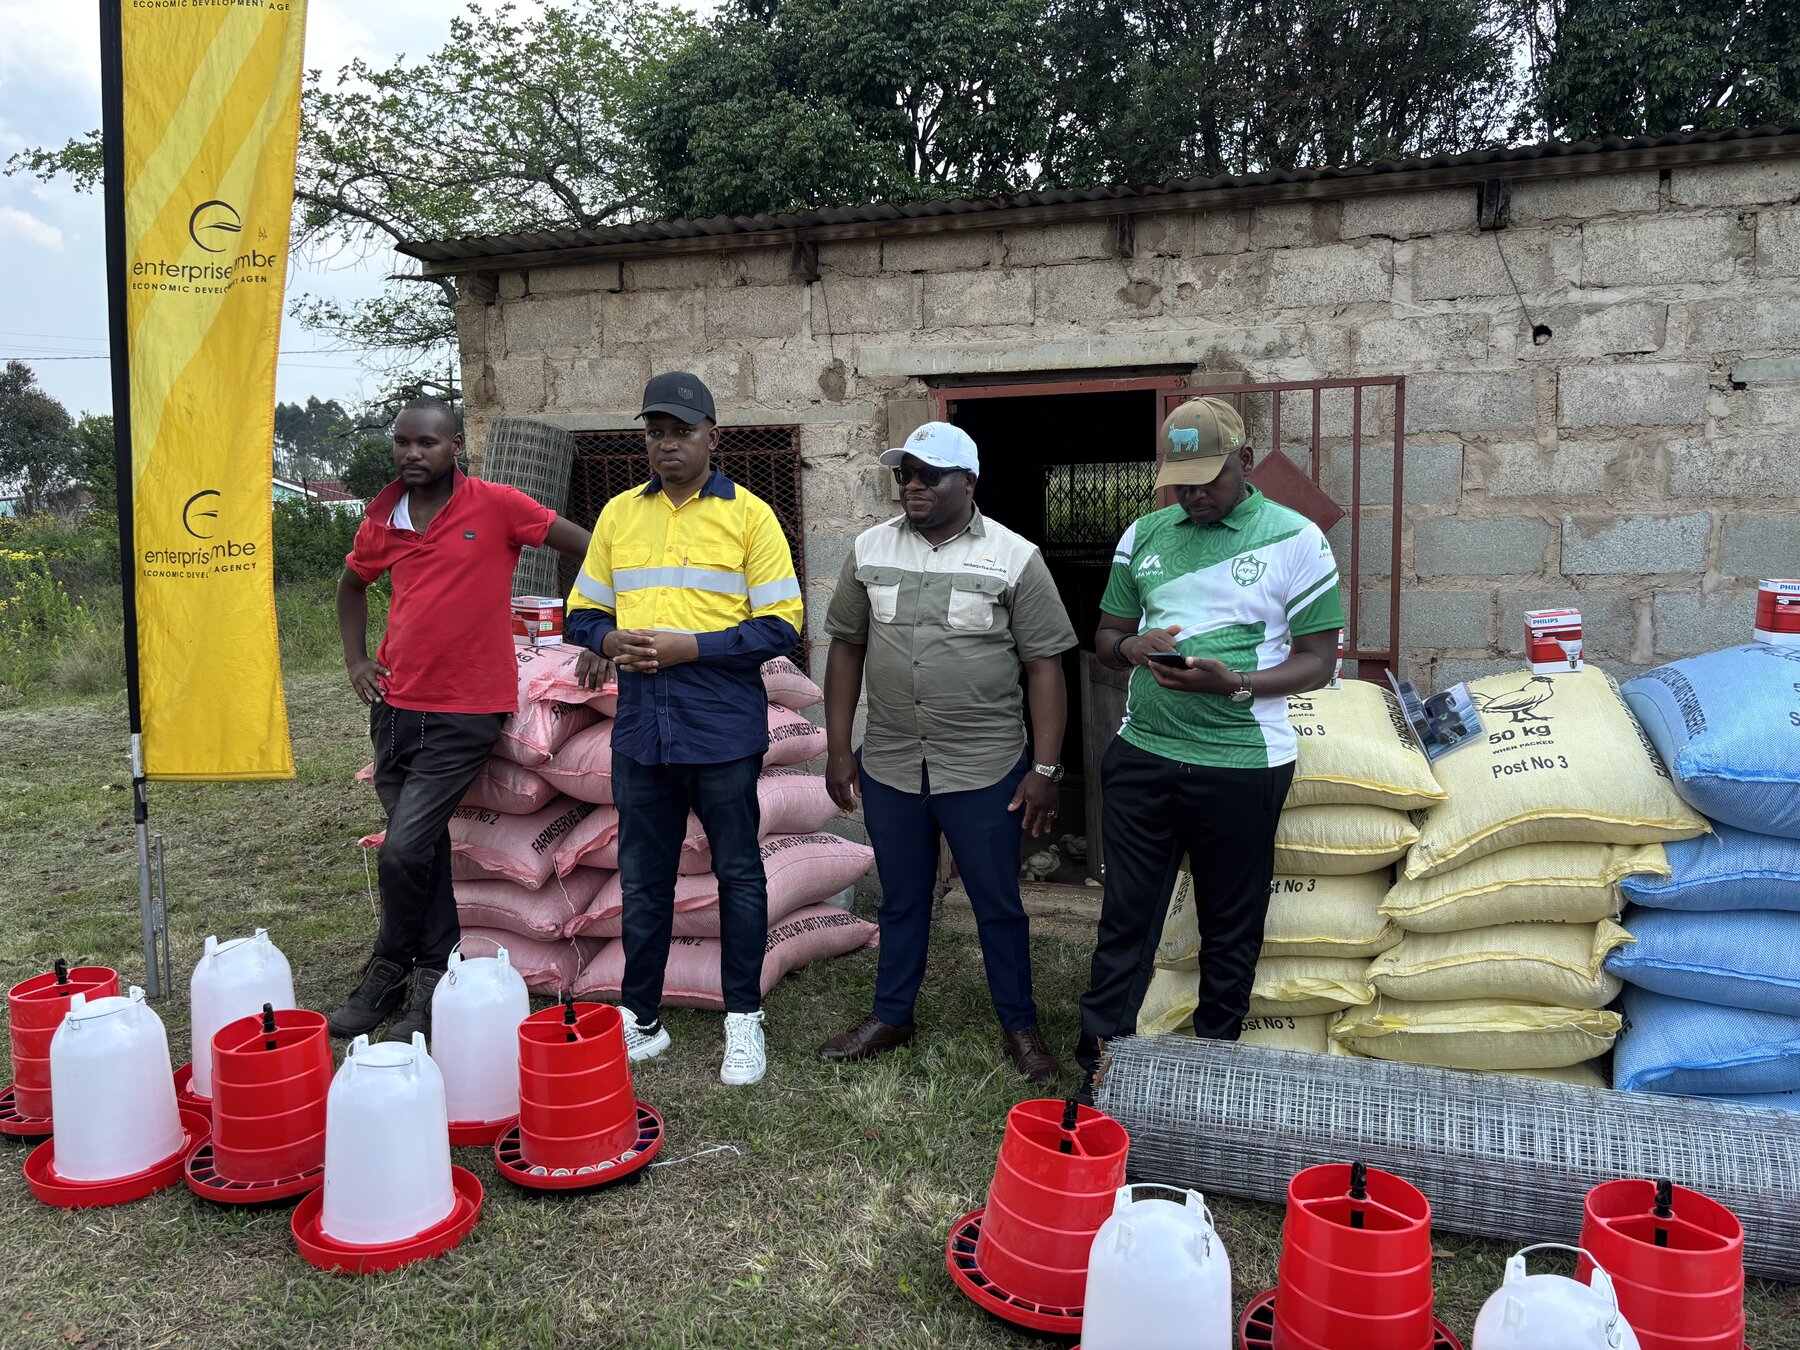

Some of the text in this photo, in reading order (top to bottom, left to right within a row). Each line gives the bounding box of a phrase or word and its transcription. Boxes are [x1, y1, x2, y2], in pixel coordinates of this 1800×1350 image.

[133, 0, 187, 8] ECONOMIC
[132, 283, 189, 292] ECONOMIC
[214, 562, 256, 573] AGENCY
[1489, 725, 1551, 745] 50 kg
[1492, 739, 1555, 755] WHEN PACKED
[1492, 755, 1569, 778] Post No 3
[475, 809, 490, 822] No
[489, 813, 500, 825] 2
[531, 810, 580, 855] FARMSERVE
[1284, 880, 1303, 892] No
[1307, 879, 1316, 892] 3
[1241, 1016, 1295, 1031] ost No 3
